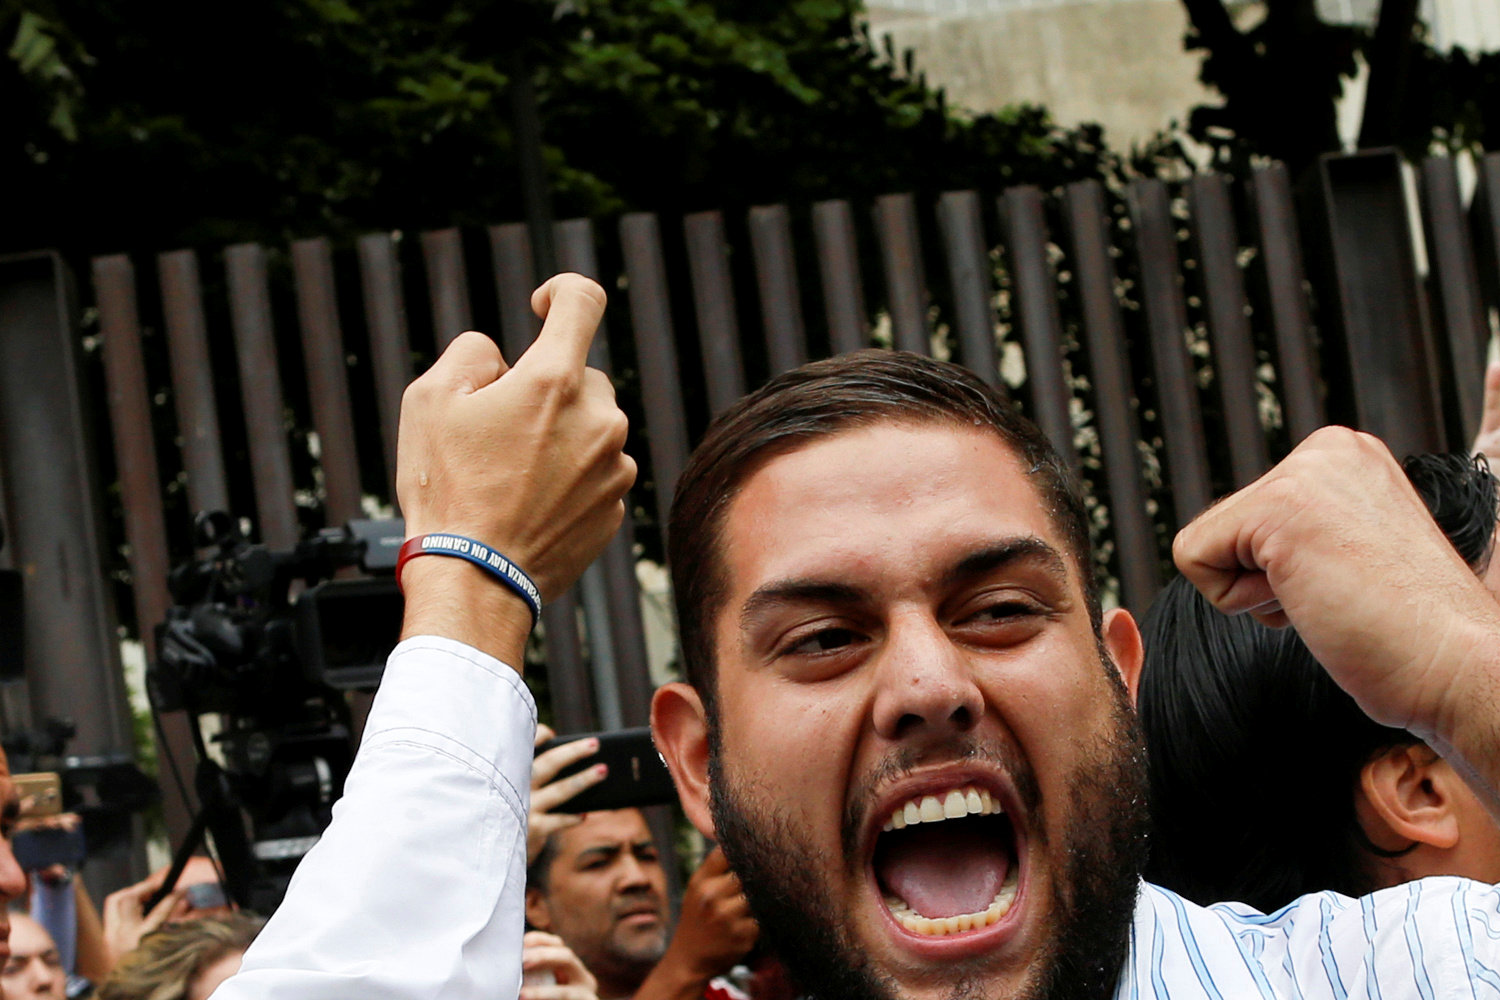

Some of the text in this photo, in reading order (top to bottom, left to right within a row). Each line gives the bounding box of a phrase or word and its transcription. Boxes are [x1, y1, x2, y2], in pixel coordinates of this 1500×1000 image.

[422, 536, 470, 553] CAMINO
[471, 543, 488, 560] UN
[488, 552, 509, 573] HAY
